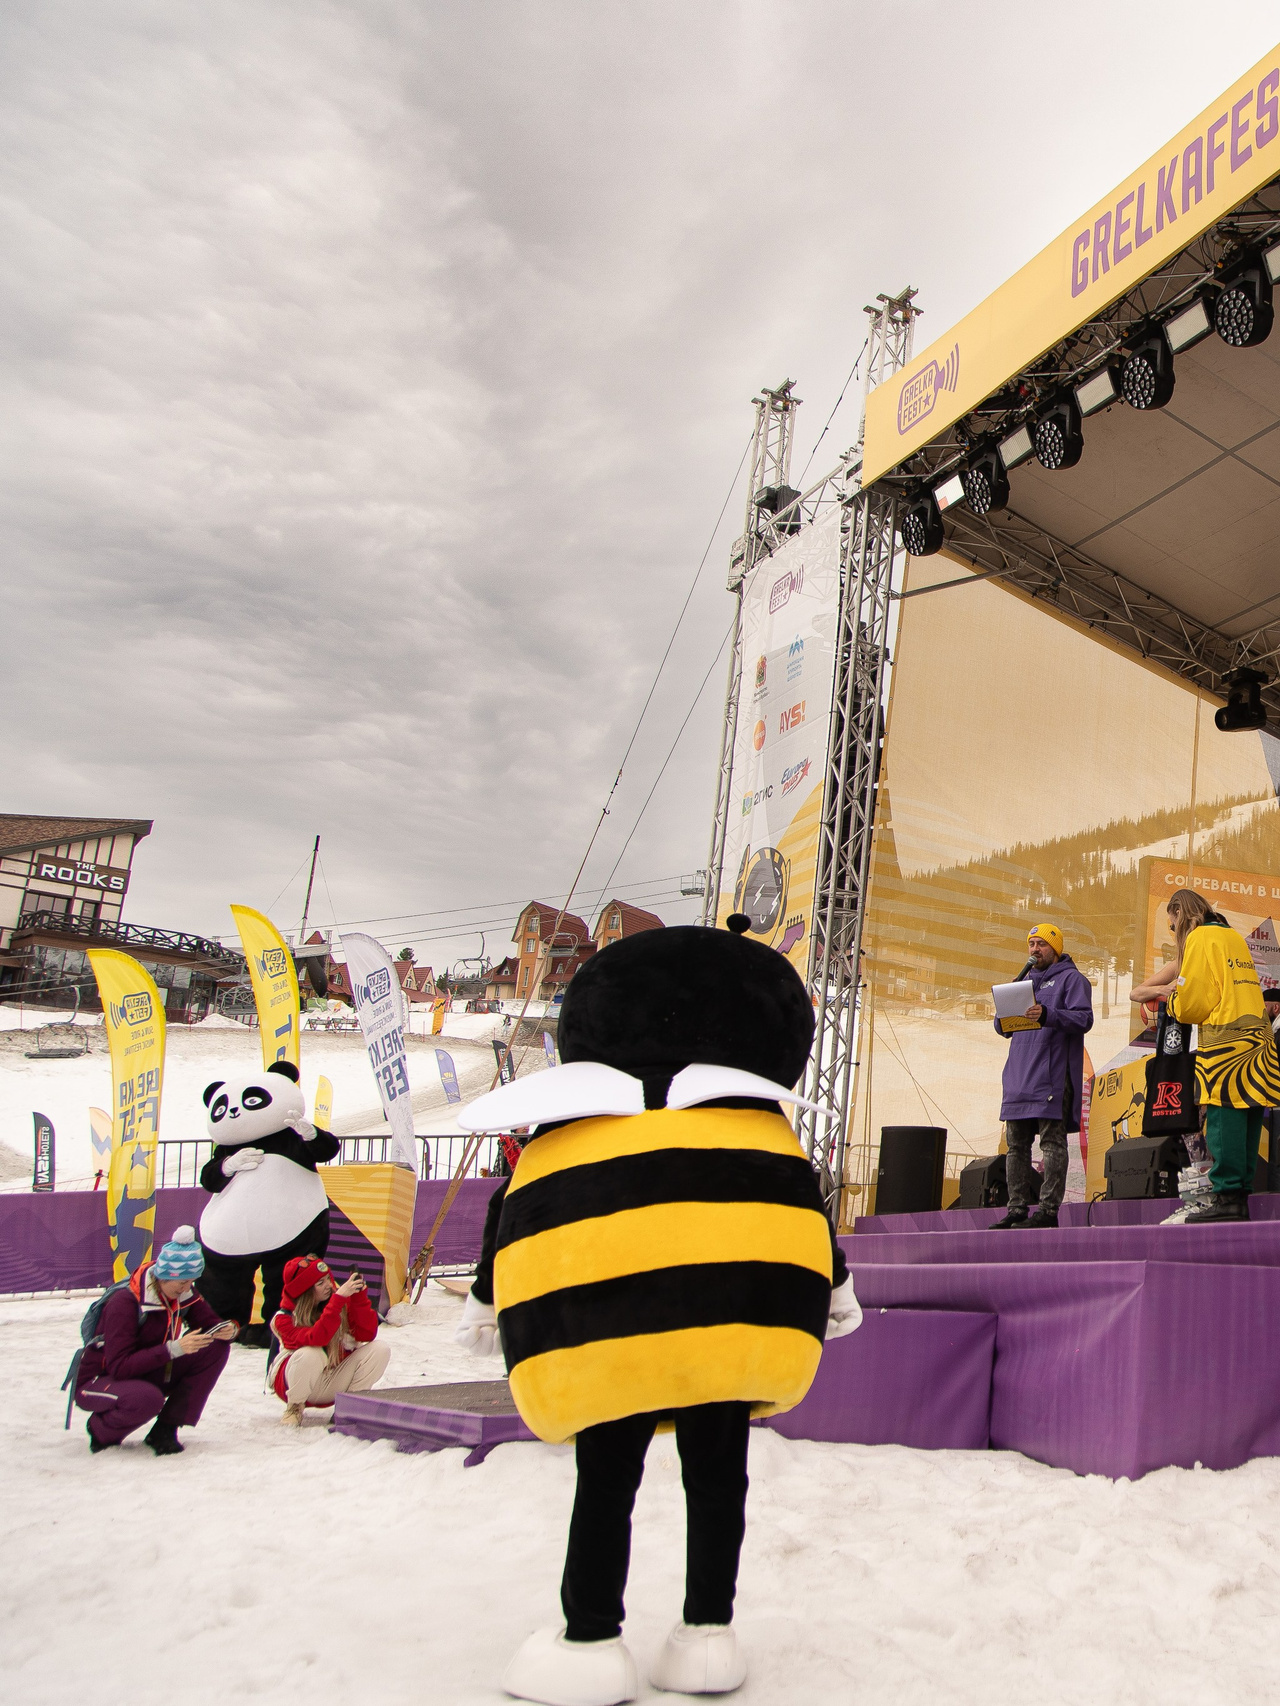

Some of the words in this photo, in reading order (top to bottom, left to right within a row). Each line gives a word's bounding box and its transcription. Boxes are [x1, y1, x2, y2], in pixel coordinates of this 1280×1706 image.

[904, 369, 934, 407] GRELKA
[902, 396, 923, 427] FEST
[779, 700, 806, 735] AYS!
[753, 784, 774, 806] 2ГИС
[41, 863, 125, 890] ROOKS
[76, 861, 96, 871] THE
[1164, 873, 1253, 896] СОГРЕВАЕМ
[1257, 885, 1267, 897] В
